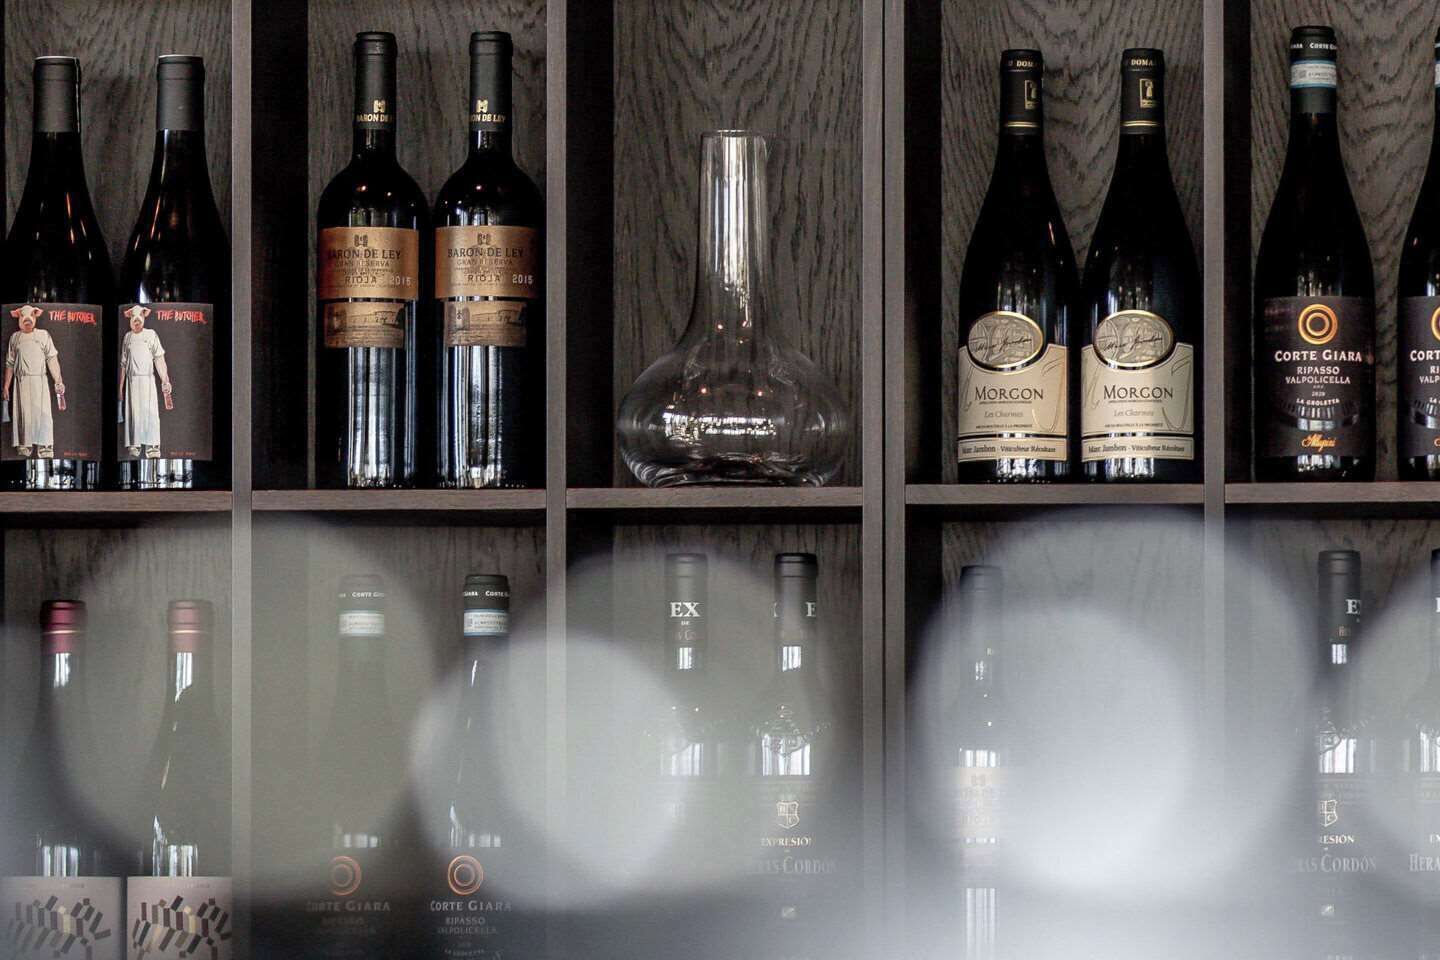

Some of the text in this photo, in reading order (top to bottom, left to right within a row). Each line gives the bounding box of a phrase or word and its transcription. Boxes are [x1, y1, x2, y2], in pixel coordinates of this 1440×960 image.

[364, 249, 401, 259] DE LEY
[487, 248, 502, 258] DE
[505, 248, 524, 258] LEY
[344, 276, 377, 284] RIOJA
[468, 274, 534, 285] RIOJA 2015
[48, 310, 66, 321] THE
[156, 310, 173, 320] THE
[1275, 349, 1362, 362] CORTE GIARA
[1297, 366, 1340, 375] RIPASSO
[1285, 376, 1350, 384] VALPOLICELLA
[975, 386, 1044, 400] MORGON
[1103, 385, 1173, 400] MORGON
[670, 602, 702, 618] EX
[430, 900, 463, 912] CORTE
